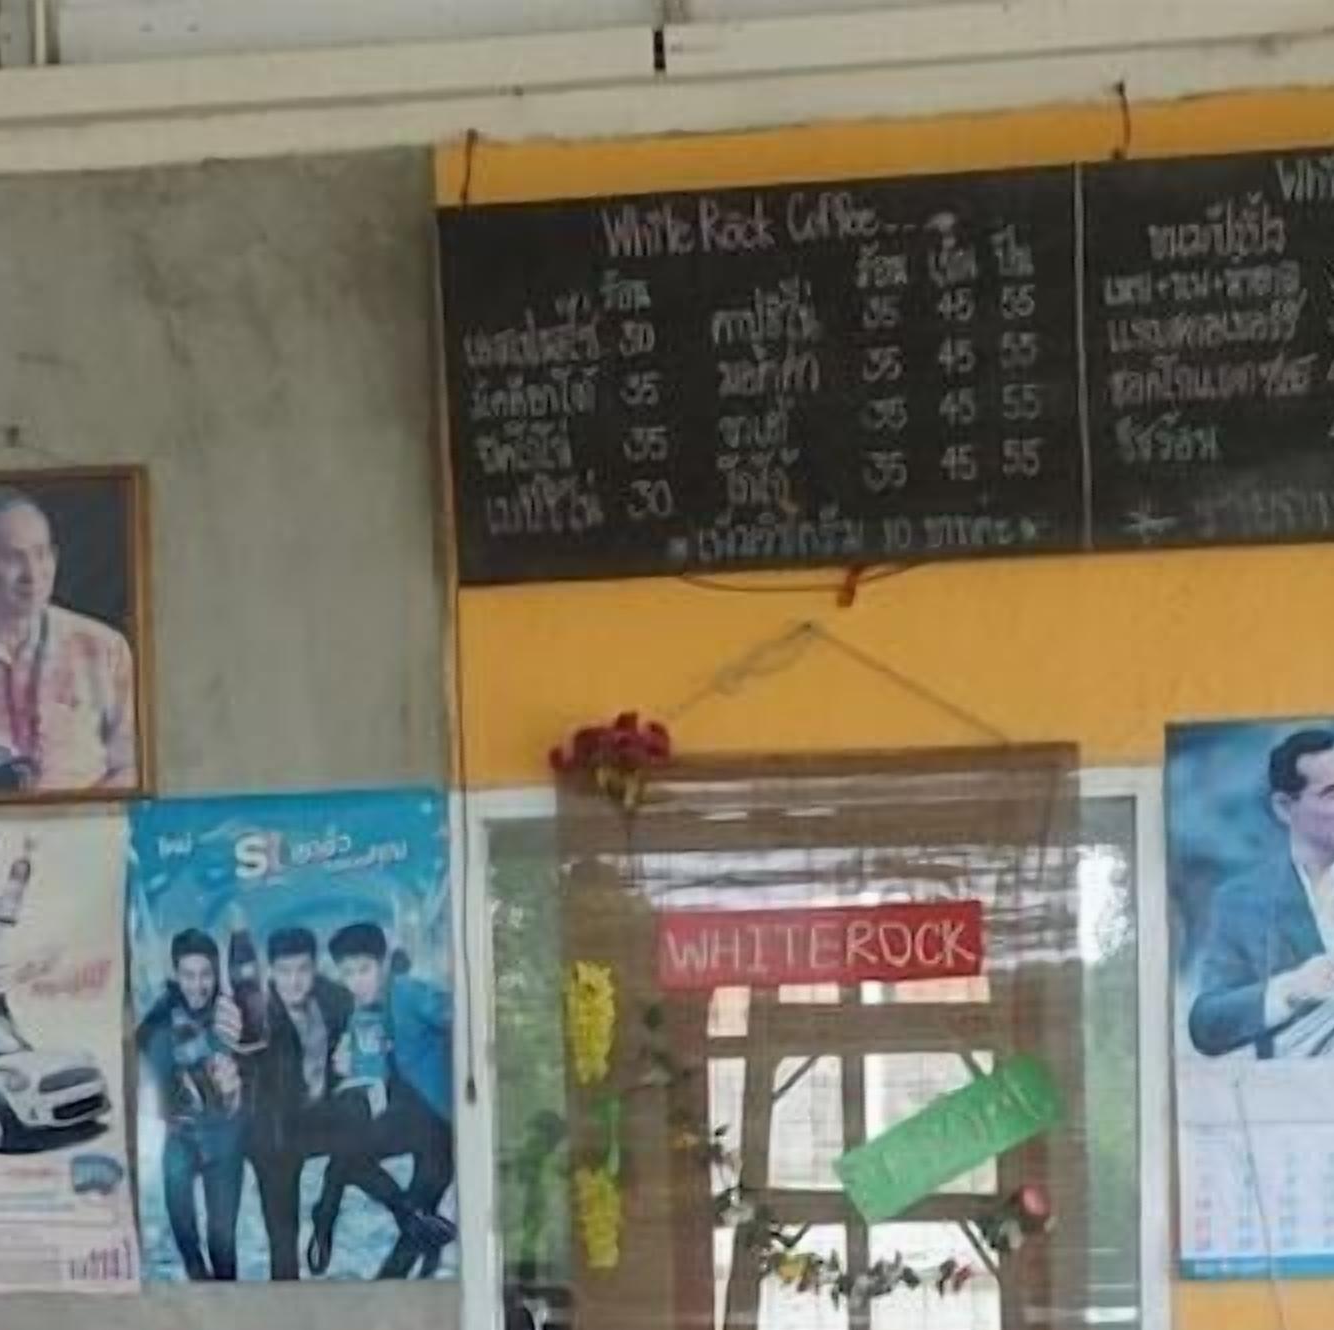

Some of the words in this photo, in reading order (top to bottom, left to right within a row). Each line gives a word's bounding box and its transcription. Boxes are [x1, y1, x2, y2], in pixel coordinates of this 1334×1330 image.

[937, 288, 976, 323] 45
[937, 339, 978, 379] 45
[938, 387, 978, 426] 45
[940, 441, 979, 482] 45
[627, 478, 672, 520] 30
